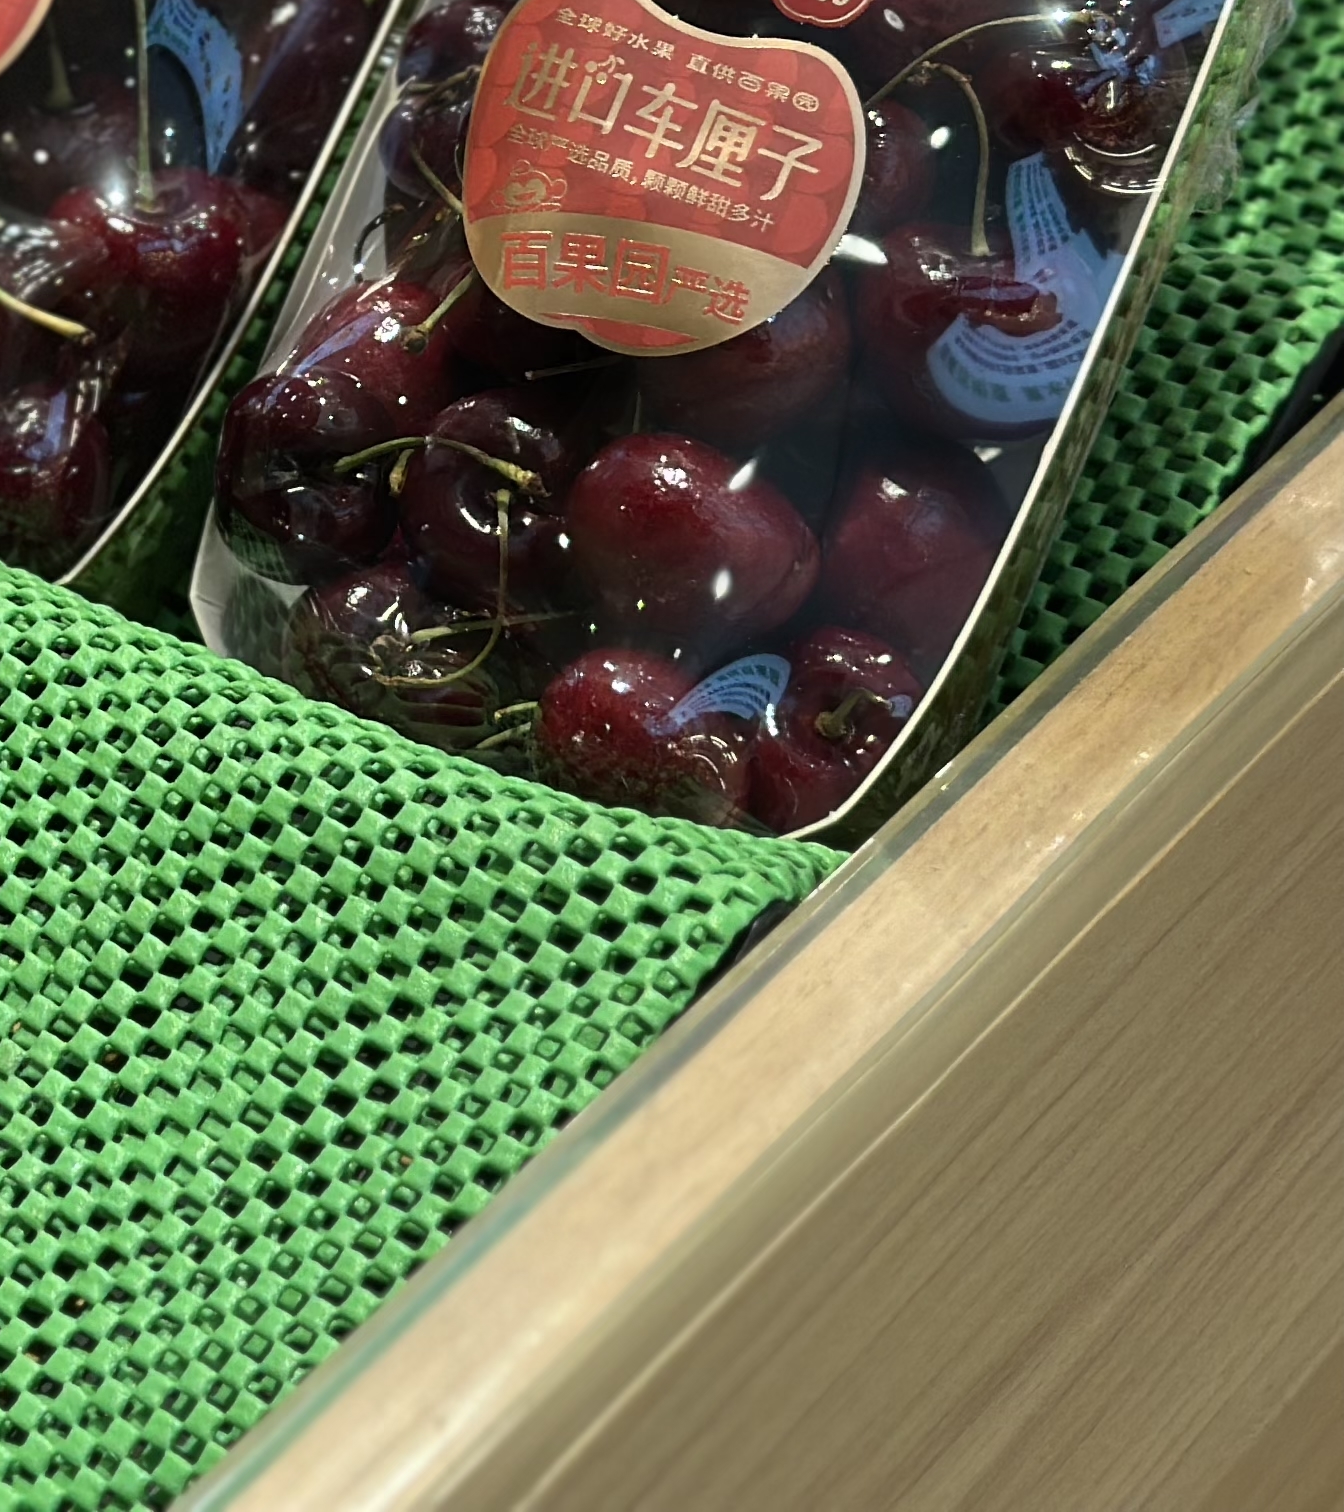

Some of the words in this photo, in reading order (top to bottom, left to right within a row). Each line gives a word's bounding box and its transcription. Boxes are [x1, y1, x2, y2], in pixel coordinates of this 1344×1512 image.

[555, 7, 675, 61] 全球好水果
[685, 52, 820, 112] 直供百果园
[504, 40, 824, 201] 进口车厘子
[500, 229, 751, 326] 百果园严选
